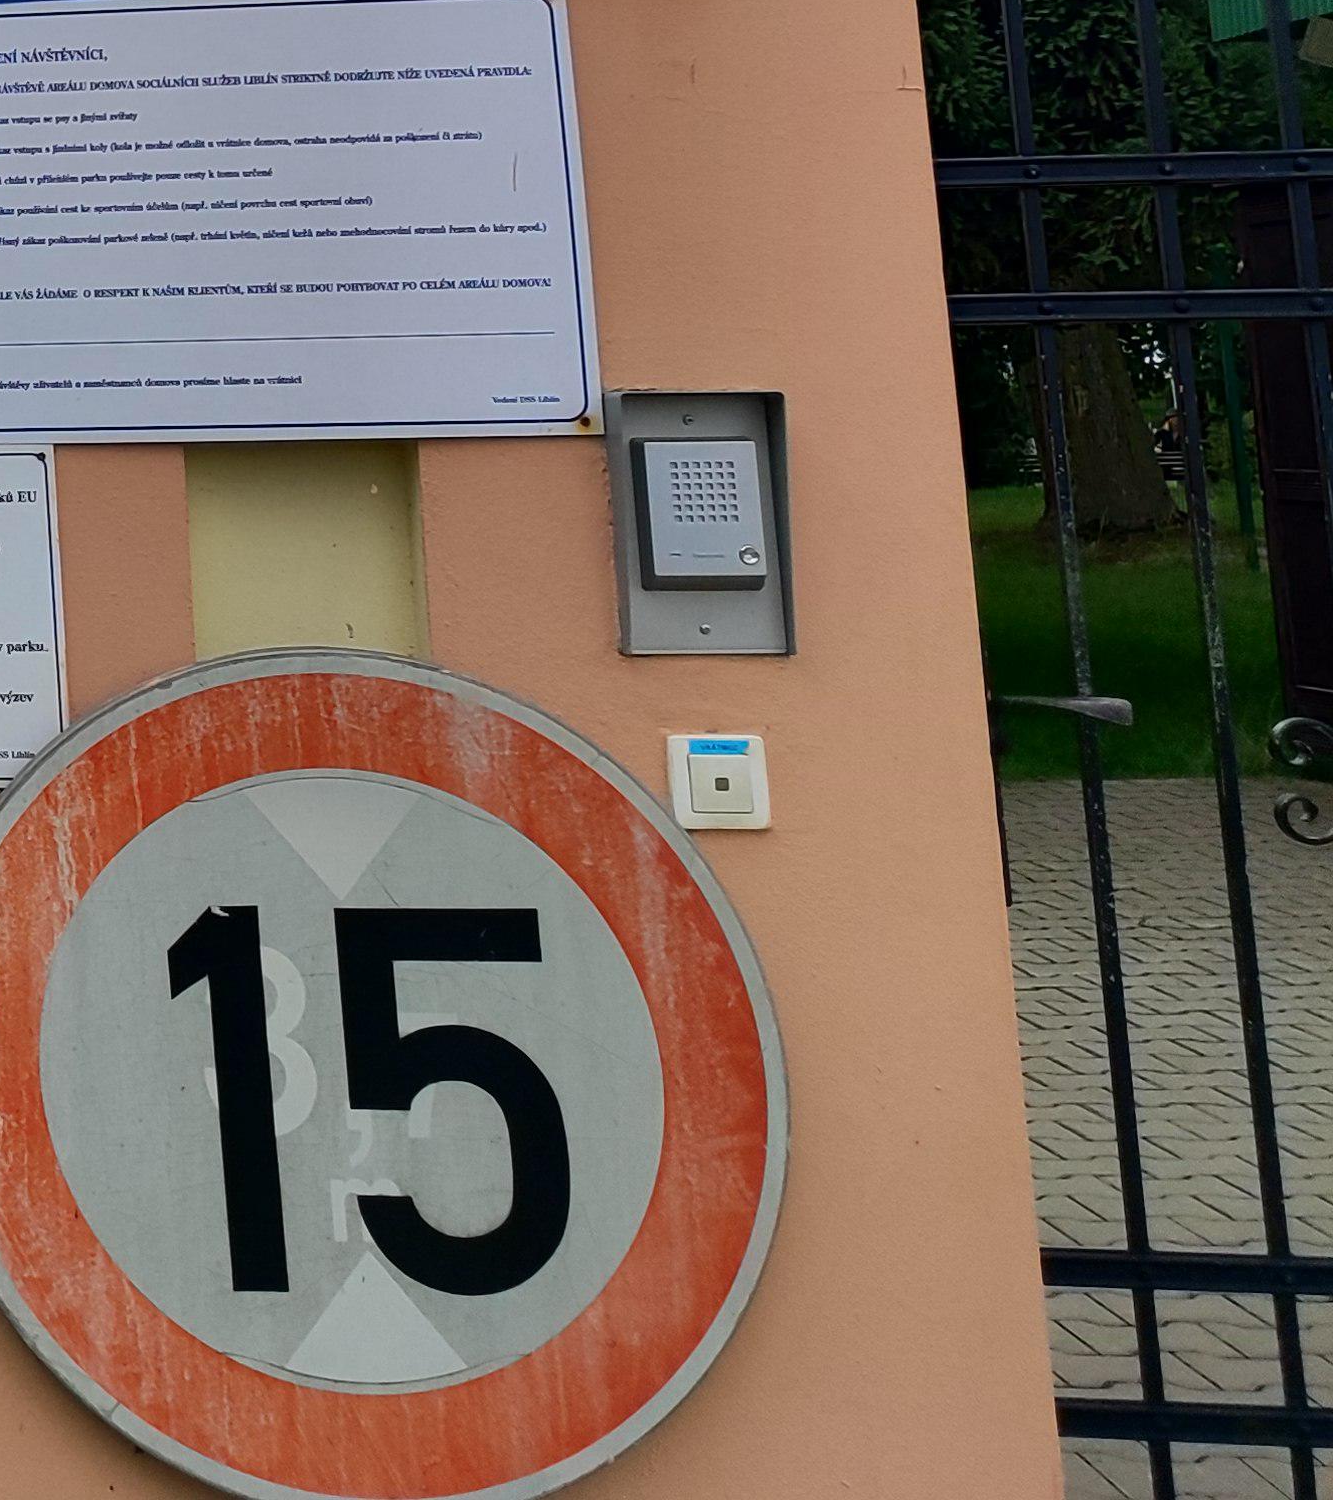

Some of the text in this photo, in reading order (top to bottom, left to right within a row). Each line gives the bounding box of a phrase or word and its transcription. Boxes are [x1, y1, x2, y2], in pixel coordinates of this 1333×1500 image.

[17, 491, 36, 502] EU
[0, 691, 33, 704] výzev
[167, 905, 570, 1296] 15
